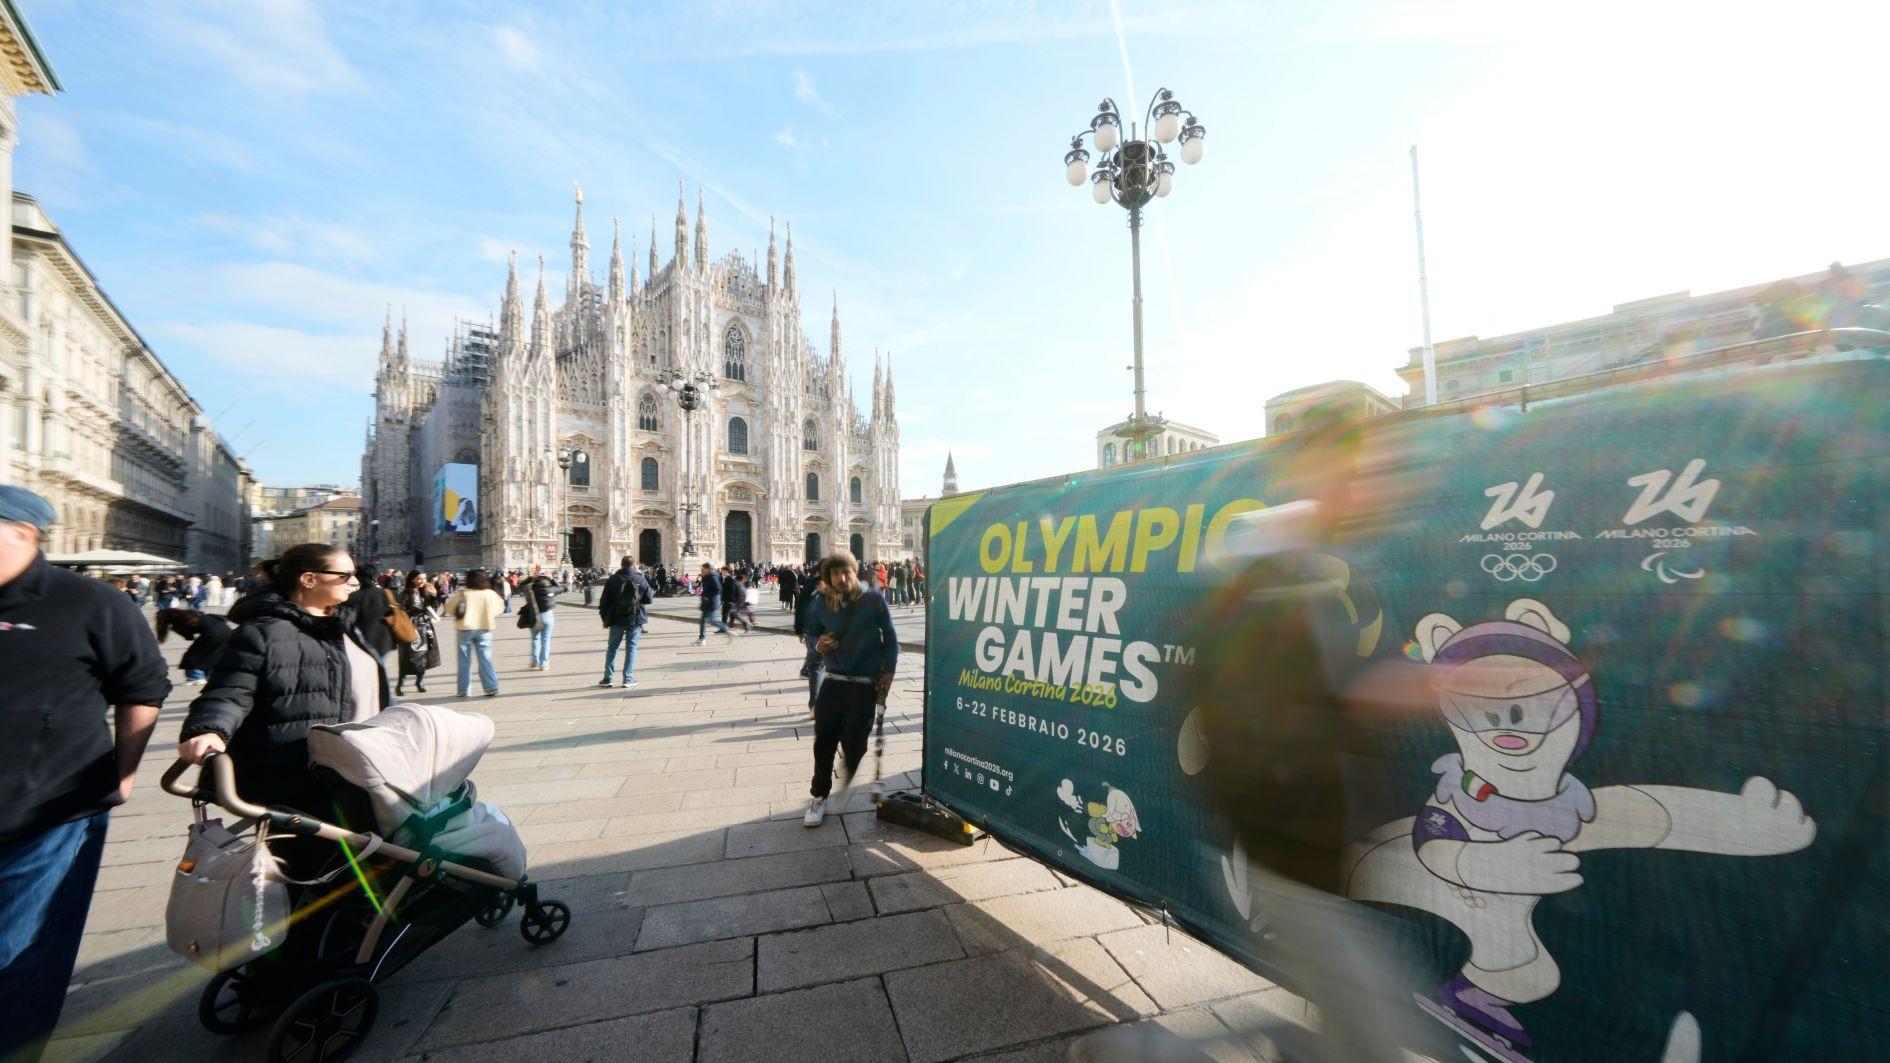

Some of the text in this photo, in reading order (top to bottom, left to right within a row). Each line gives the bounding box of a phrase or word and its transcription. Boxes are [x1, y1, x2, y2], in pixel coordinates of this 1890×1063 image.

[1458, 531, 1582, 542] MILANO CORTINA
[1594, 526, 1759, 539] MILANO CORTINA
[1652, 538, 1691, 549] 2026
[1503, 542, 1532, 551] 2026
[948, 576, 1127, 635] WINTER
[958, 668, 1118, 709] Milano Cortina 2026
[992, 706, 1069, 740] FEBBRAIO
[1077, 728, 1126, 756] 2026
[944, 746, 1014, 782] milanocortina2026.org
